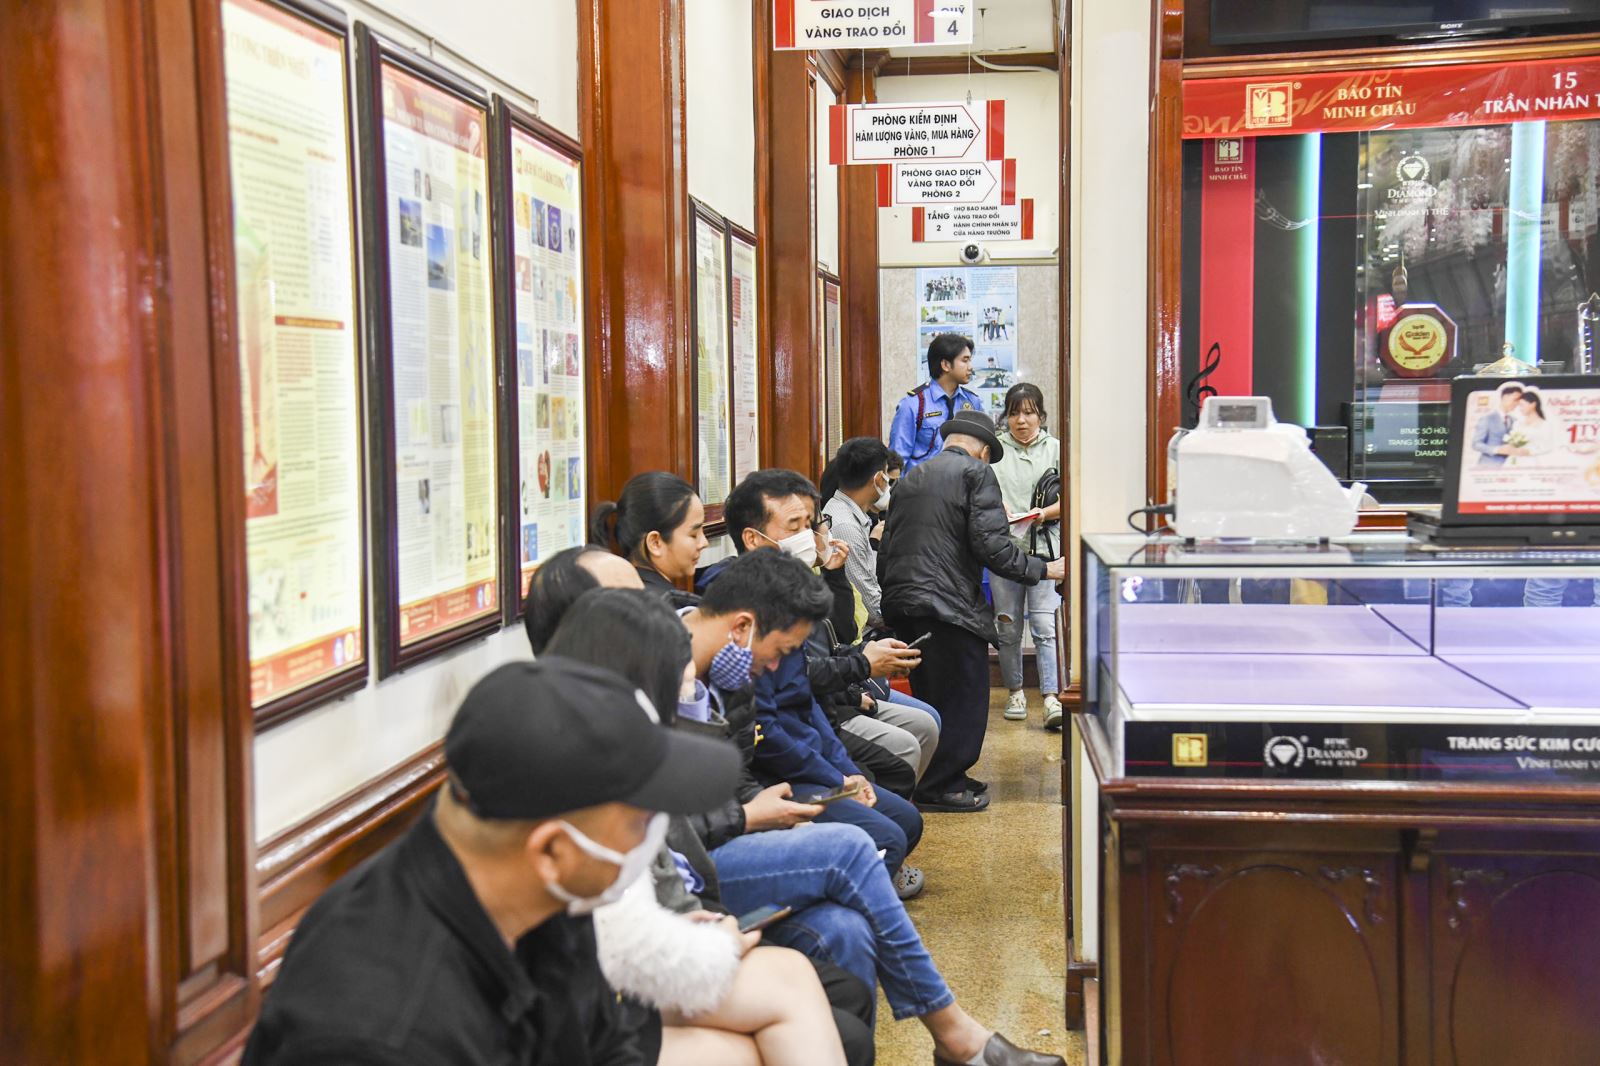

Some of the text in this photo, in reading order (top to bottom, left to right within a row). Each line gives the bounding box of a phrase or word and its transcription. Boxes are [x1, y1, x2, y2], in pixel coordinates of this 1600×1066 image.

[821, 7, 890, 20] GIAO DỊCH
[805, 20, 906, 38] VÀNG TRAO ĐỔI
[947, 20, 959, 36] 4
[1552, 71, 1577, 89] 15
[1338, 82, 1402, 101] BẢO TÍN
[1323, 100, 1416, 119] MINH CHÂU
[1535, 92, 1589, 111] NHÂN
[872, 109, 957, 126] PHÒNG KIỂM ĐỊNH
[855, 127, 974, 143] HÀM LƯỢNG VÀNG, MUA HÀNG
[893, 144, 936, 156] PHÒNG 1
[901, 168, 932, 177] PHÒNG
[959, 169, 981, 178] DỊCH
[908, 179, 932, 187] VÀNG
[959, 176, 975, 186] ĐỔI
[928, 210, 949, 220] TẦNG
[1447, 736, 1501, 750] TRANG
[1503, 734, 1537, 751] SỨC
[1539, 737, 1570, 751] KIM
[1306, 747, 1368, 760] DIAMOND
